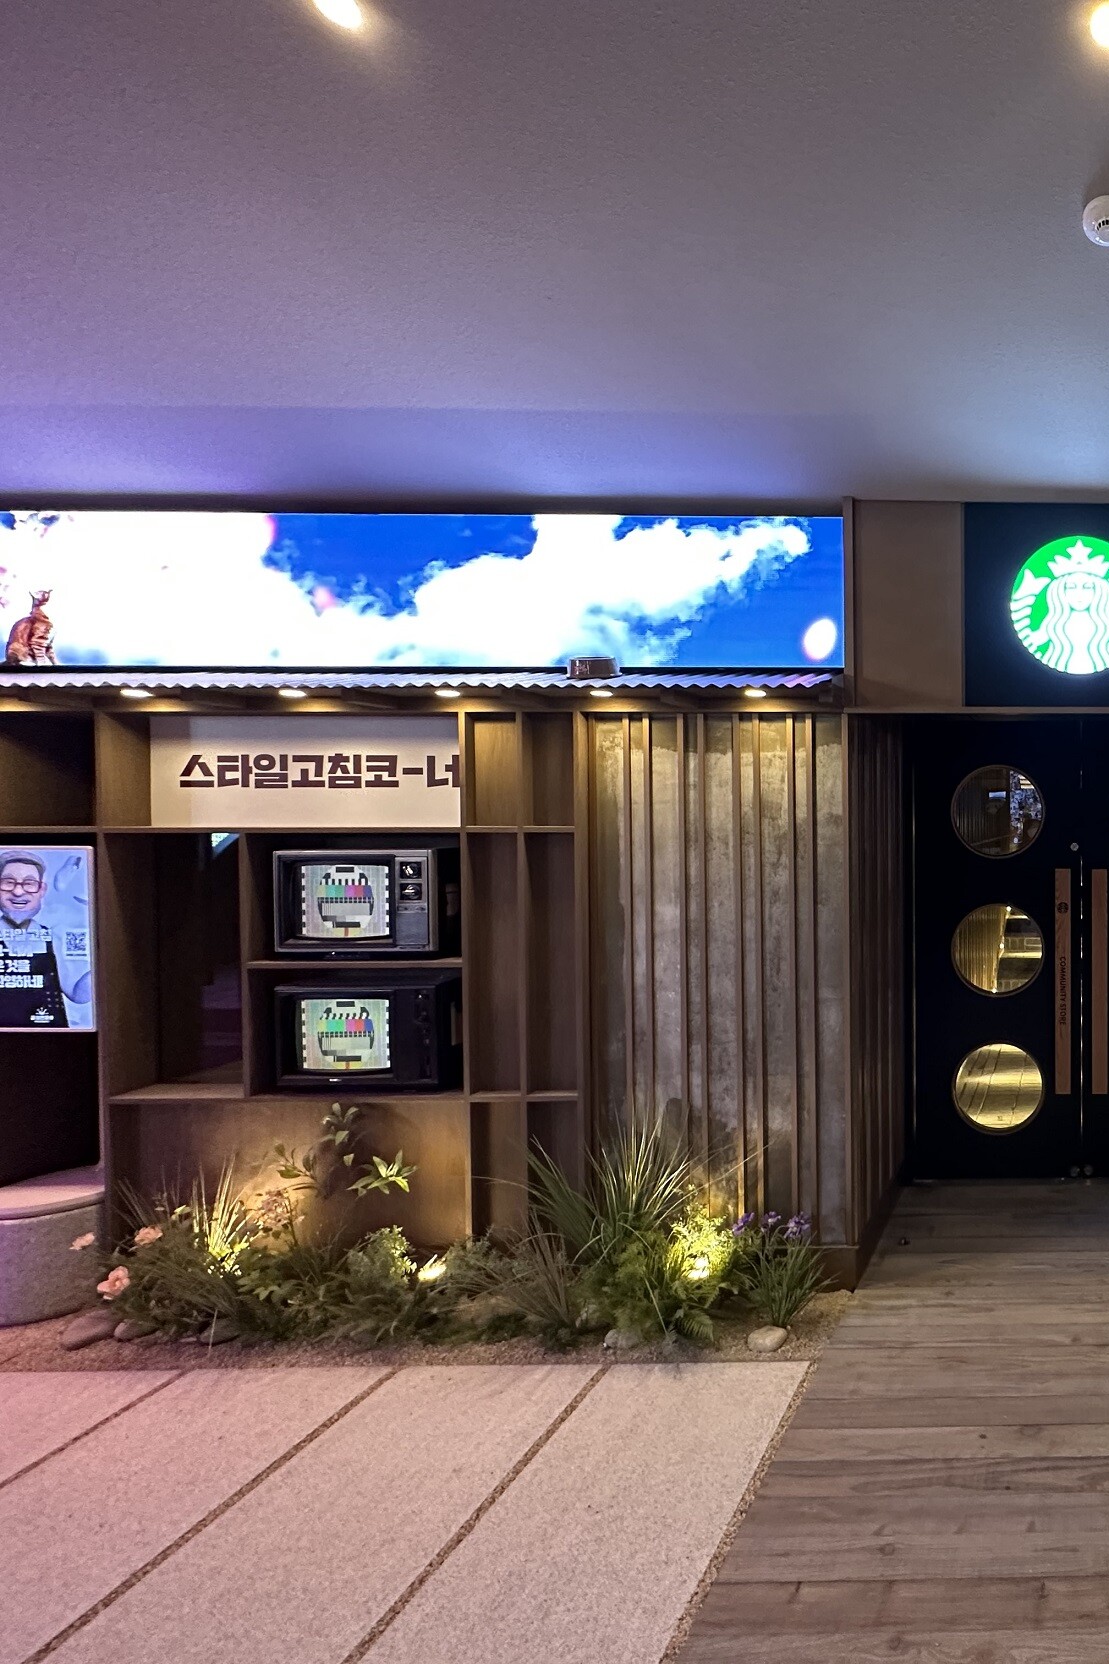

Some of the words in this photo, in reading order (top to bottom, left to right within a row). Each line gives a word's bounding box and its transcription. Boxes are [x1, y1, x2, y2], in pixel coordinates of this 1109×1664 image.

[179, 753, 460, 789] 스타일고침코-너
[1059, 956, 1067, 1002] COMMUNITY
[1059, 1003, 1067, 1026] STORE
